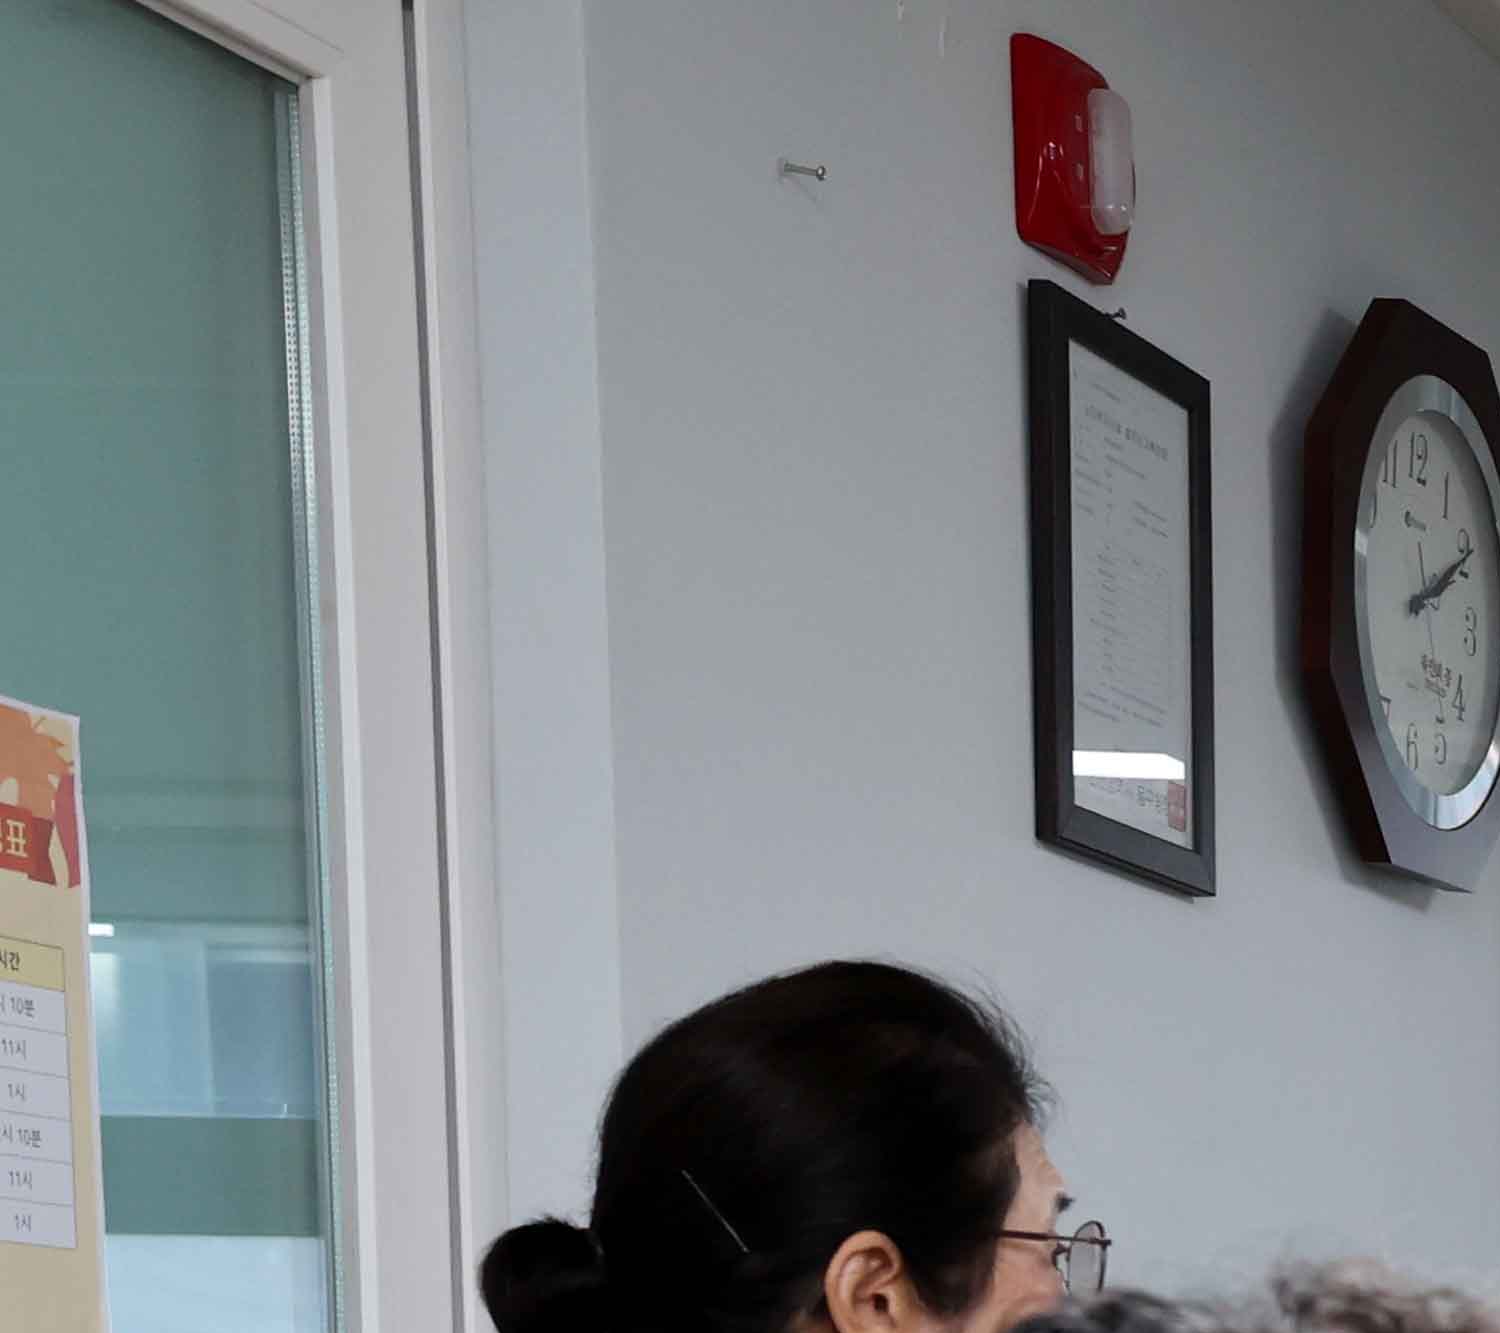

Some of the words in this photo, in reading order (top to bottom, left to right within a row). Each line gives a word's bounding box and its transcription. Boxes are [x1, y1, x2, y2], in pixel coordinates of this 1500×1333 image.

[1409, 432, 1428, 486] 12
[1442, 471, 1450, 520] 1
[1457, 528, 1470, 579] 2
[1464, 606, 1477, 657] 3
[1452, 673, 1465, 722] 4
[0, 818, 29, 860] 표
